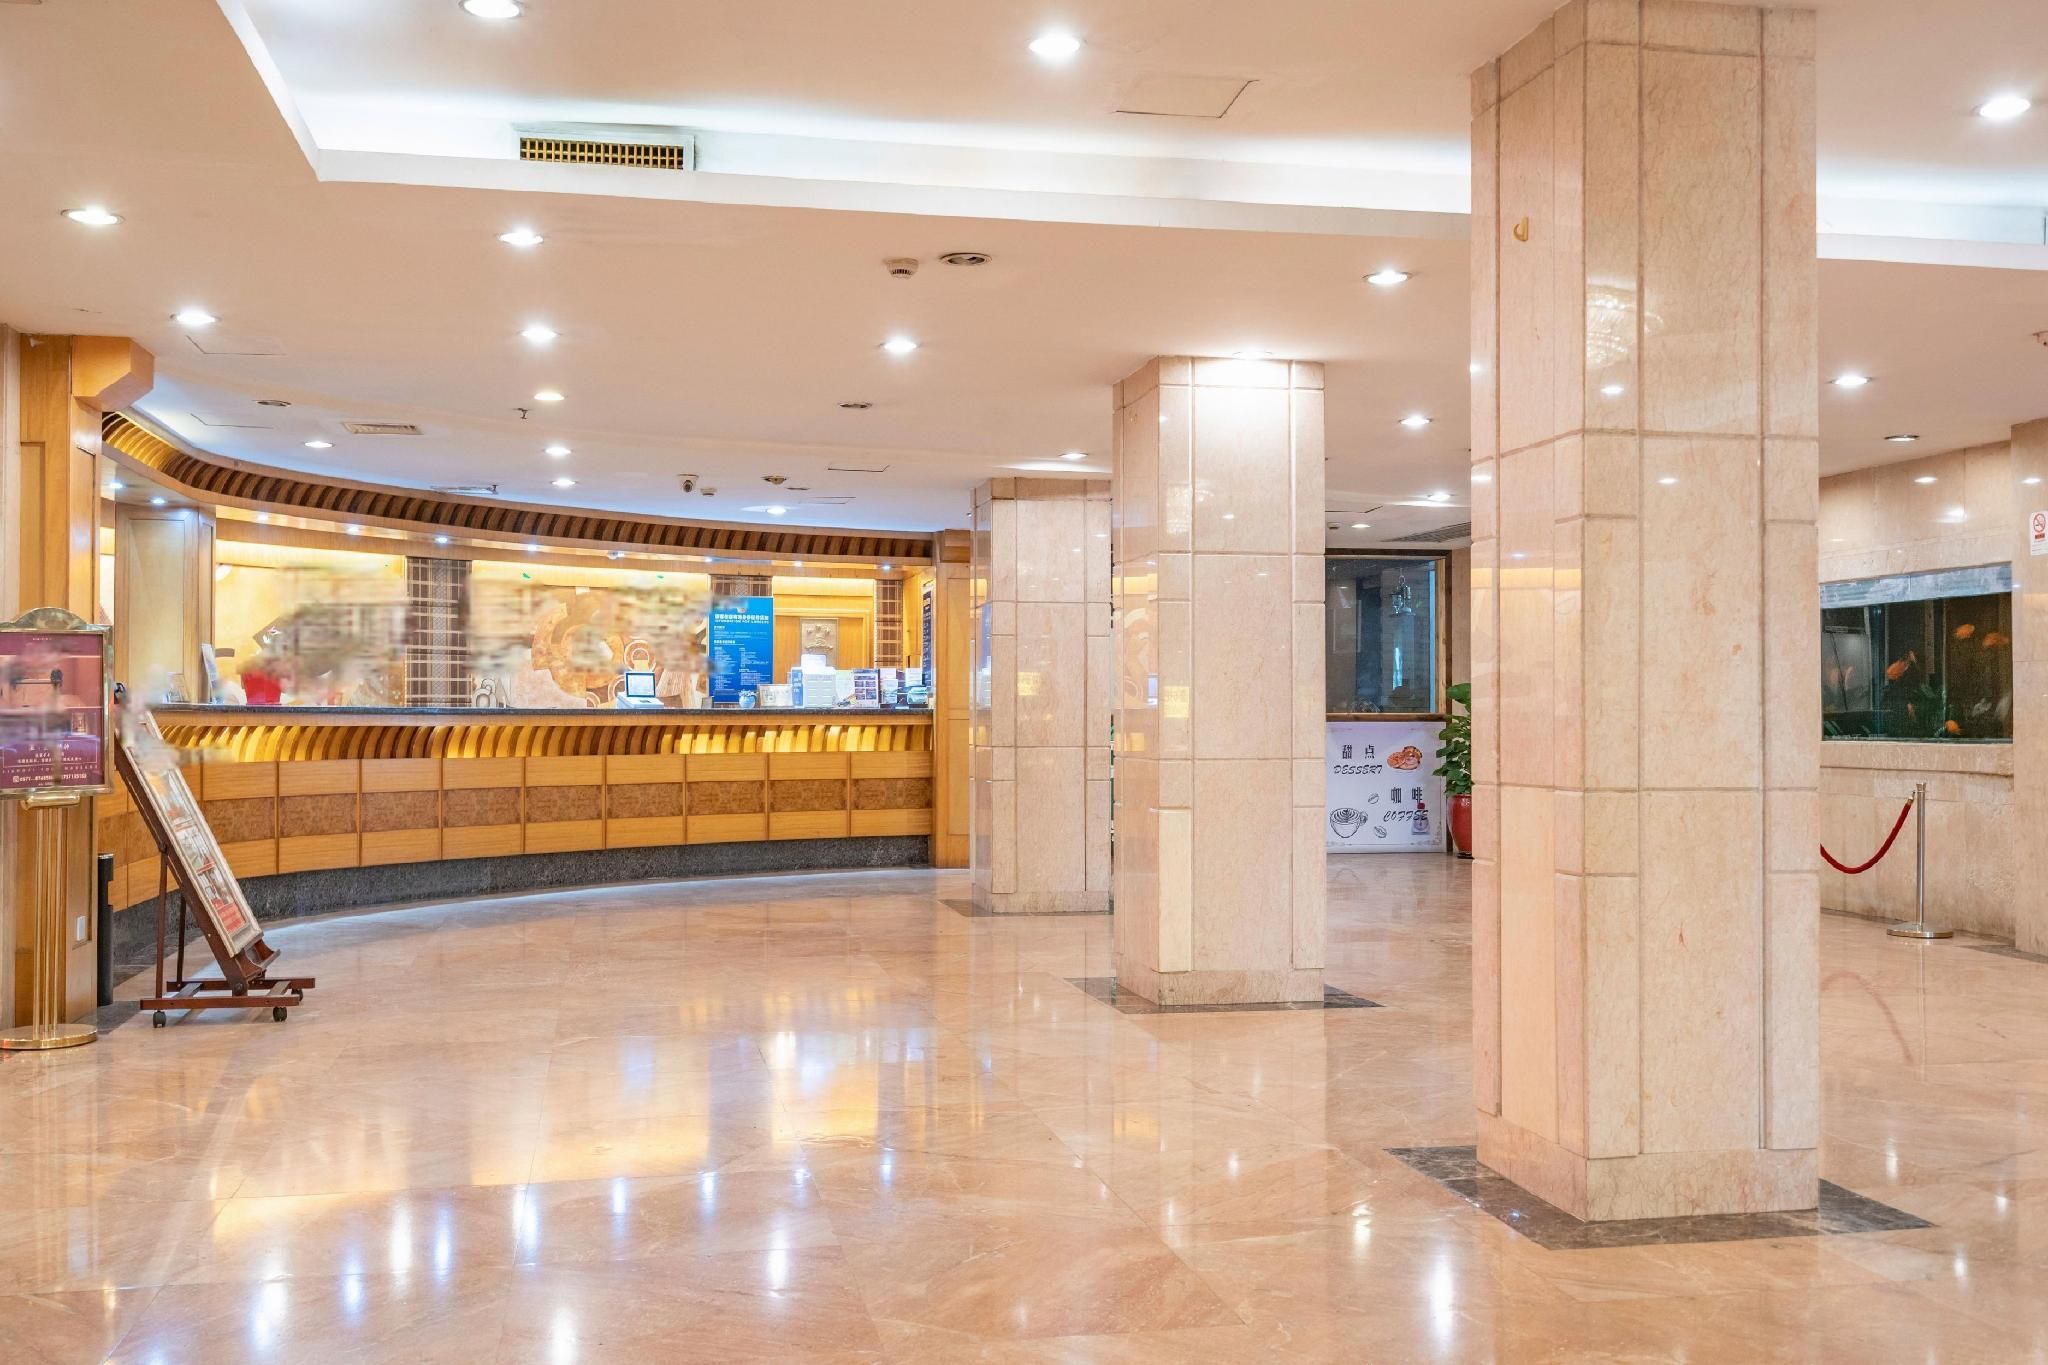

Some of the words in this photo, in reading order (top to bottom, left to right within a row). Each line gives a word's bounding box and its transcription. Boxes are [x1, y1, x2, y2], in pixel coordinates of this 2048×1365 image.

[1342, 744, 1375, 759] 甜点
[1333, 764, 1383, 775] DESSERT
[1390, 787, 1423, 804] 咖啡
